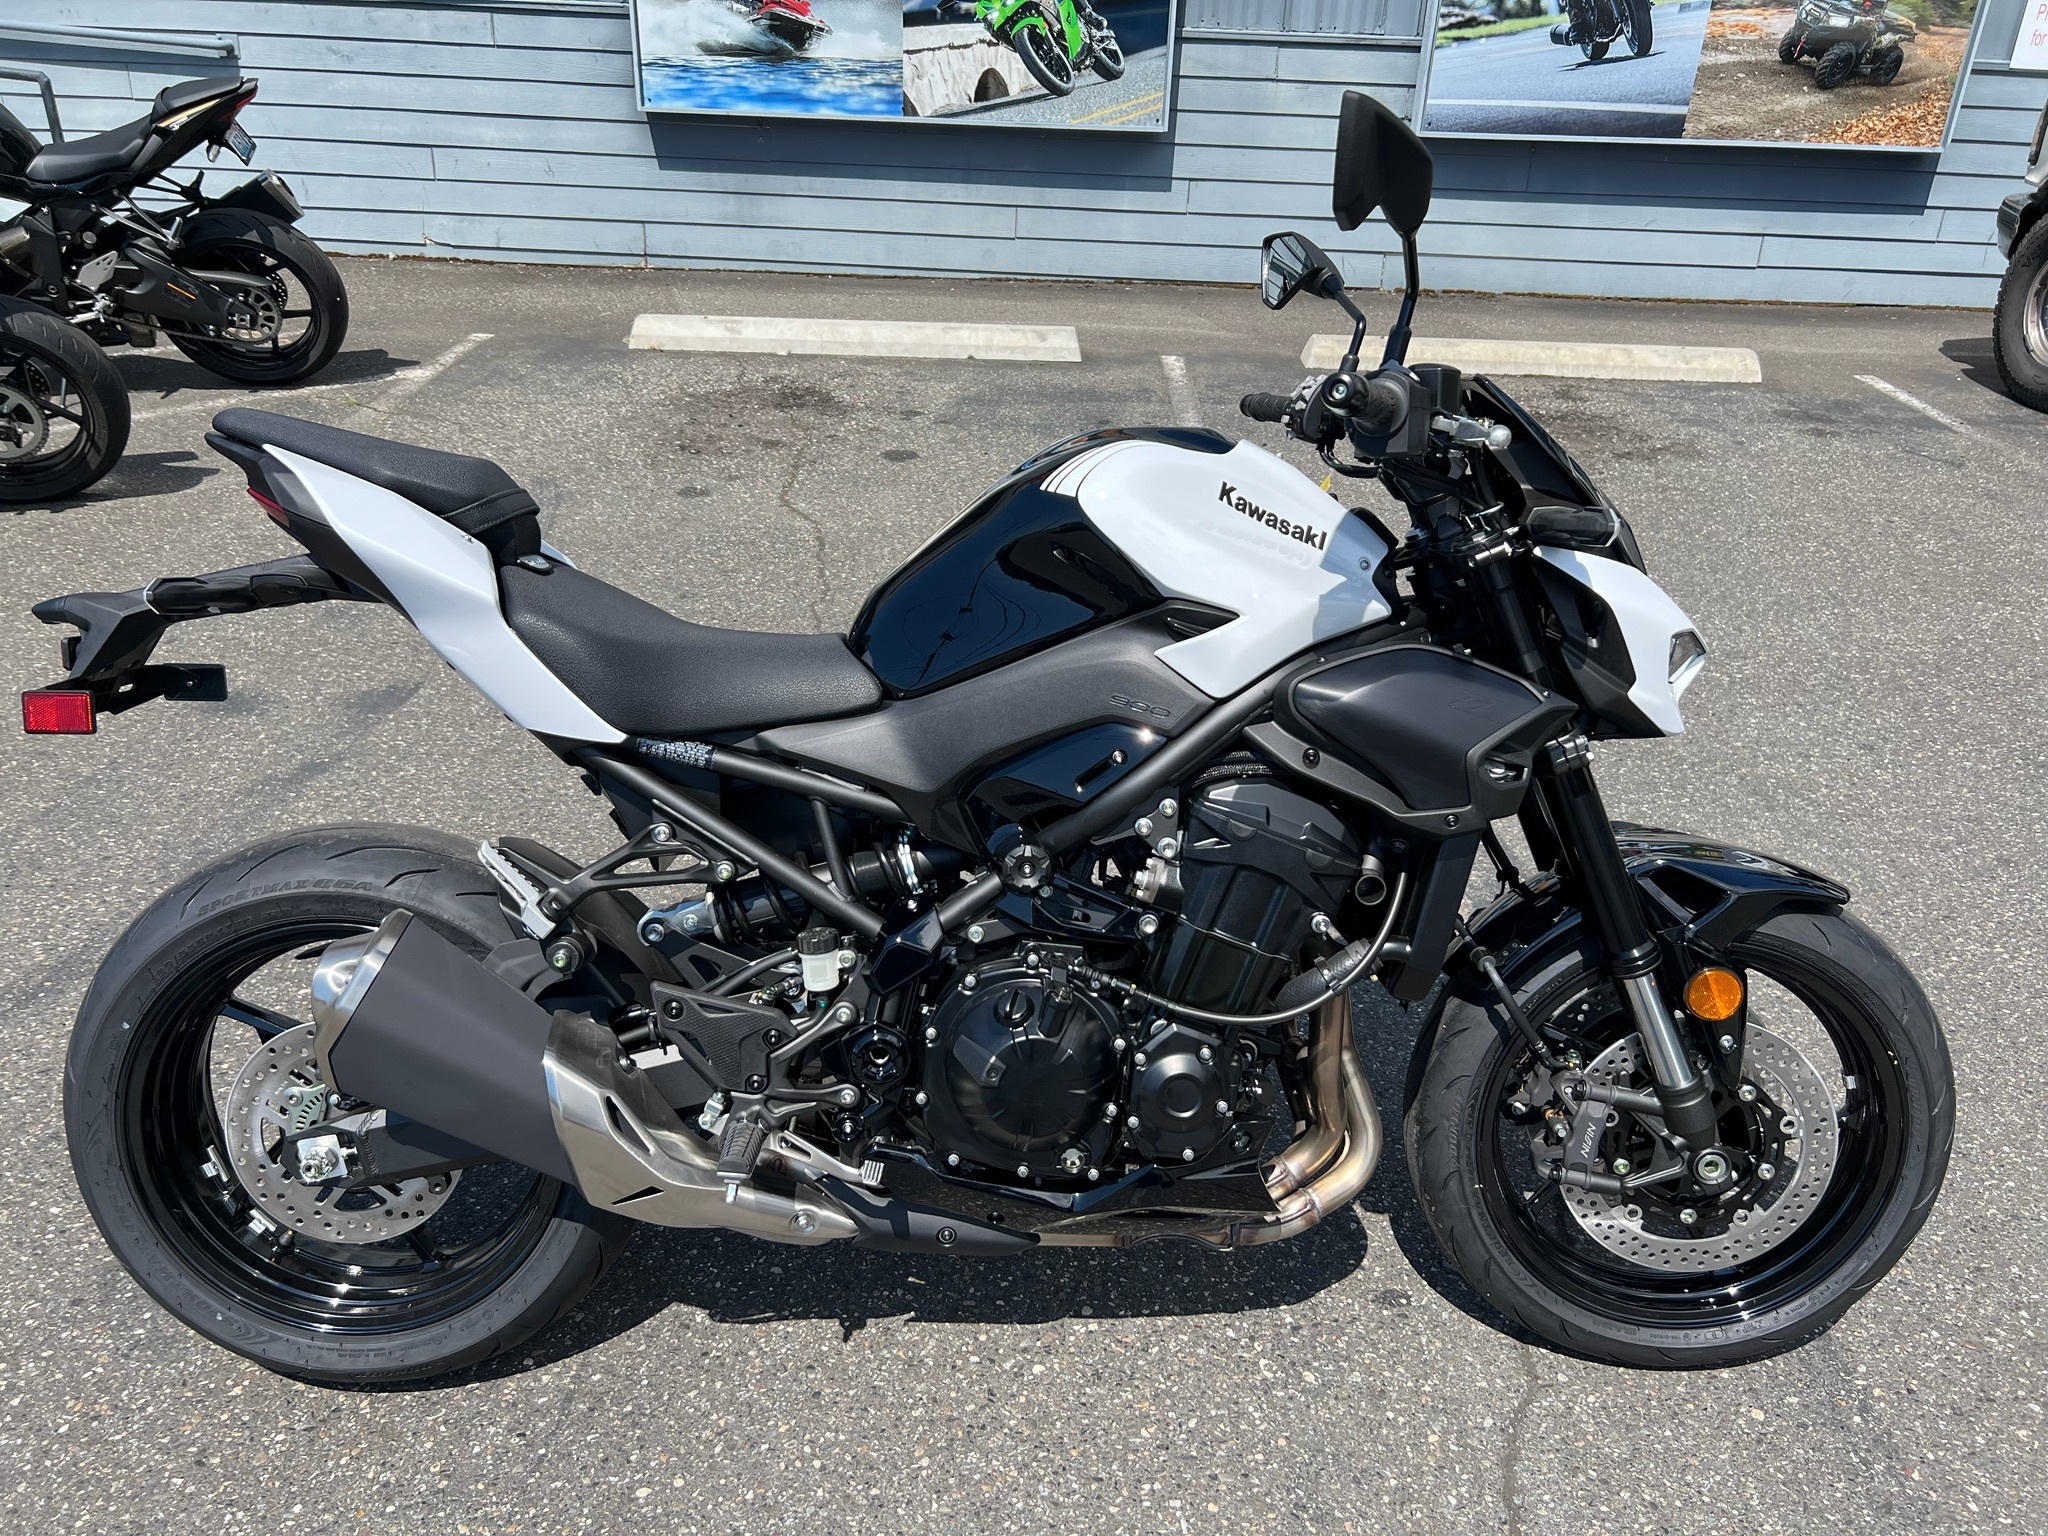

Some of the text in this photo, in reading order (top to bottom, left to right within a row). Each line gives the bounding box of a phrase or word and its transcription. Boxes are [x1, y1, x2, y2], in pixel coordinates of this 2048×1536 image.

[2036, 4, 2048, 20] P
[2031, 29, 2047, 46] for
[1218, 480, 1327, 551] Kawasaki
[1109, 694, 1171, 718] 900
[198, 878, 310, 918] SPORTMAX
[1580, 1121, 1597, 1159] NISSIN
